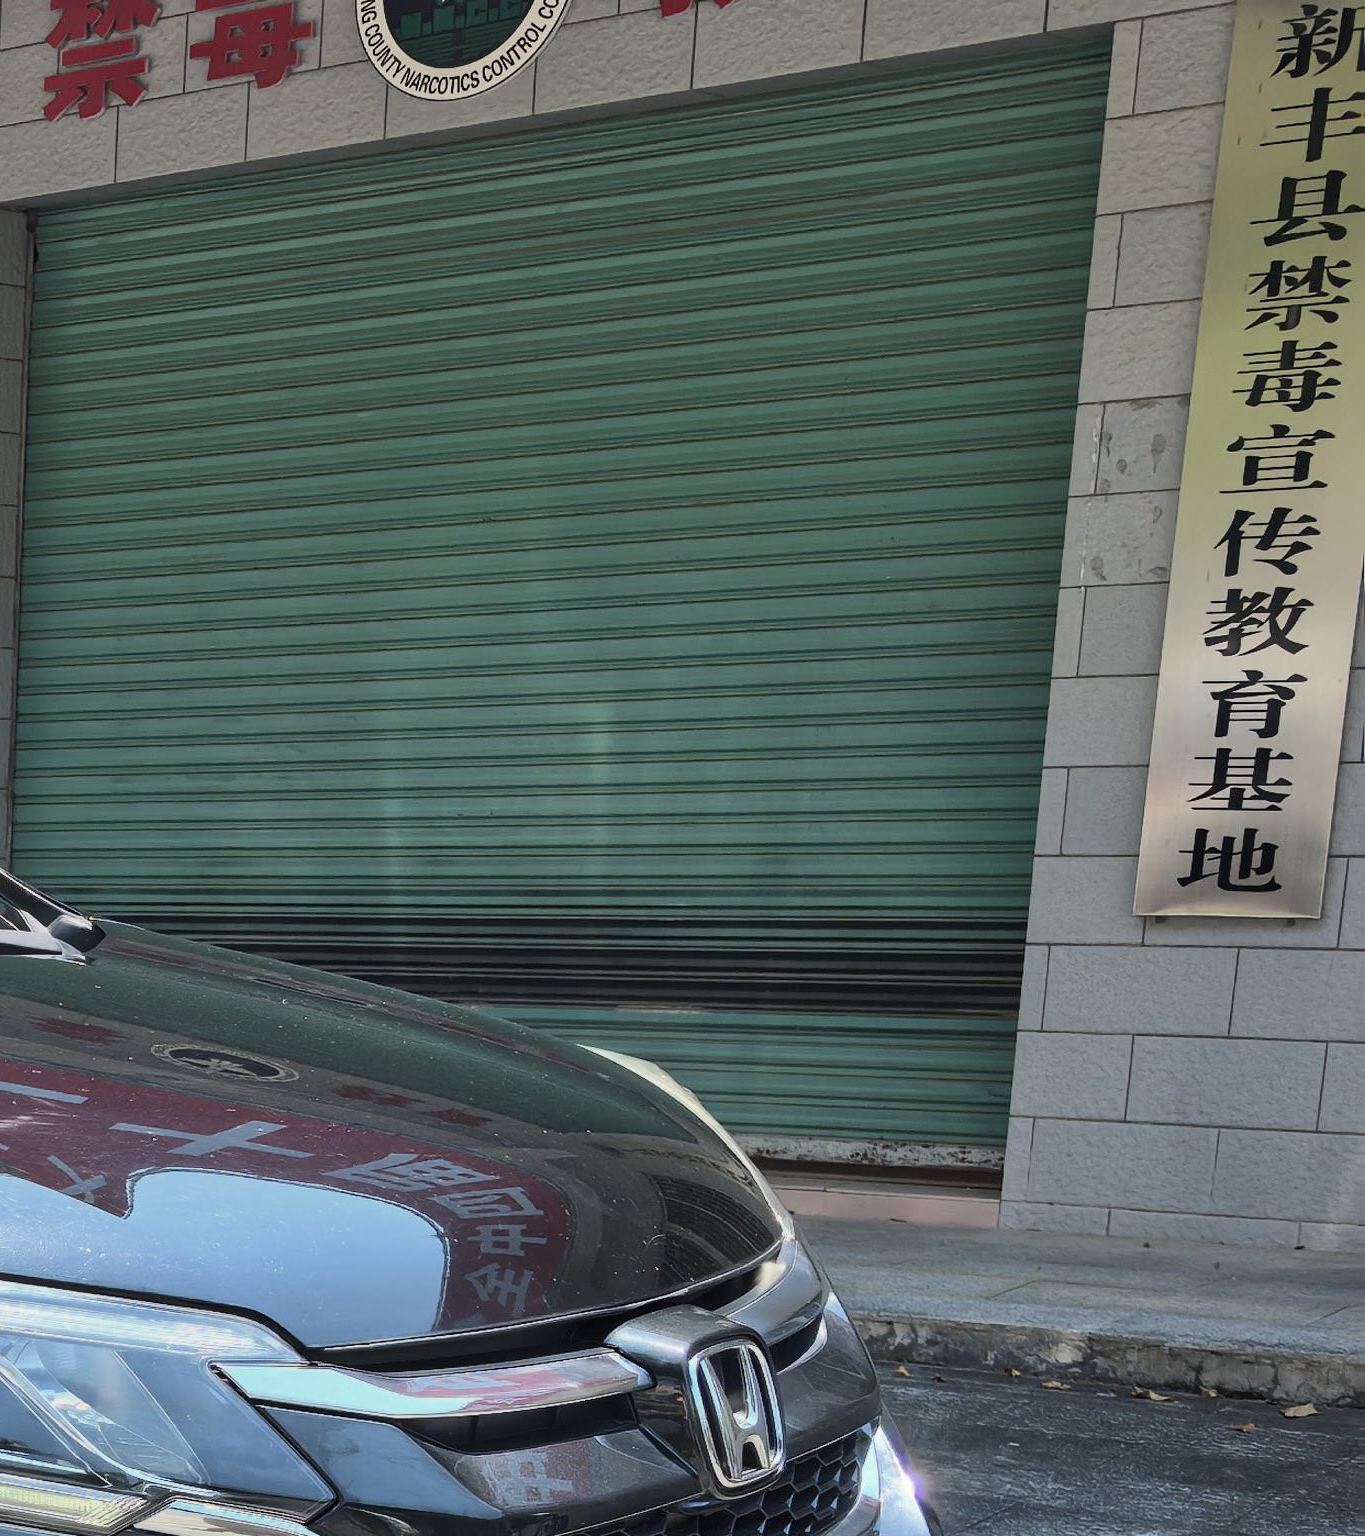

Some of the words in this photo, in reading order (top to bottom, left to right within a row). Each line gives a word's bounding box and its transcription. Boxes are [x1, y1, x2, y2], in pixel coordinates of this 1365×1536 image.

[365, 23, 405, 79] COUNTY
[400, 67, 479, 95] NARCOTICS
[482, 22, 547, 82] CONTROL
[1176, 4, 1365, 893] 新丰县禁毒宣传教育基地
